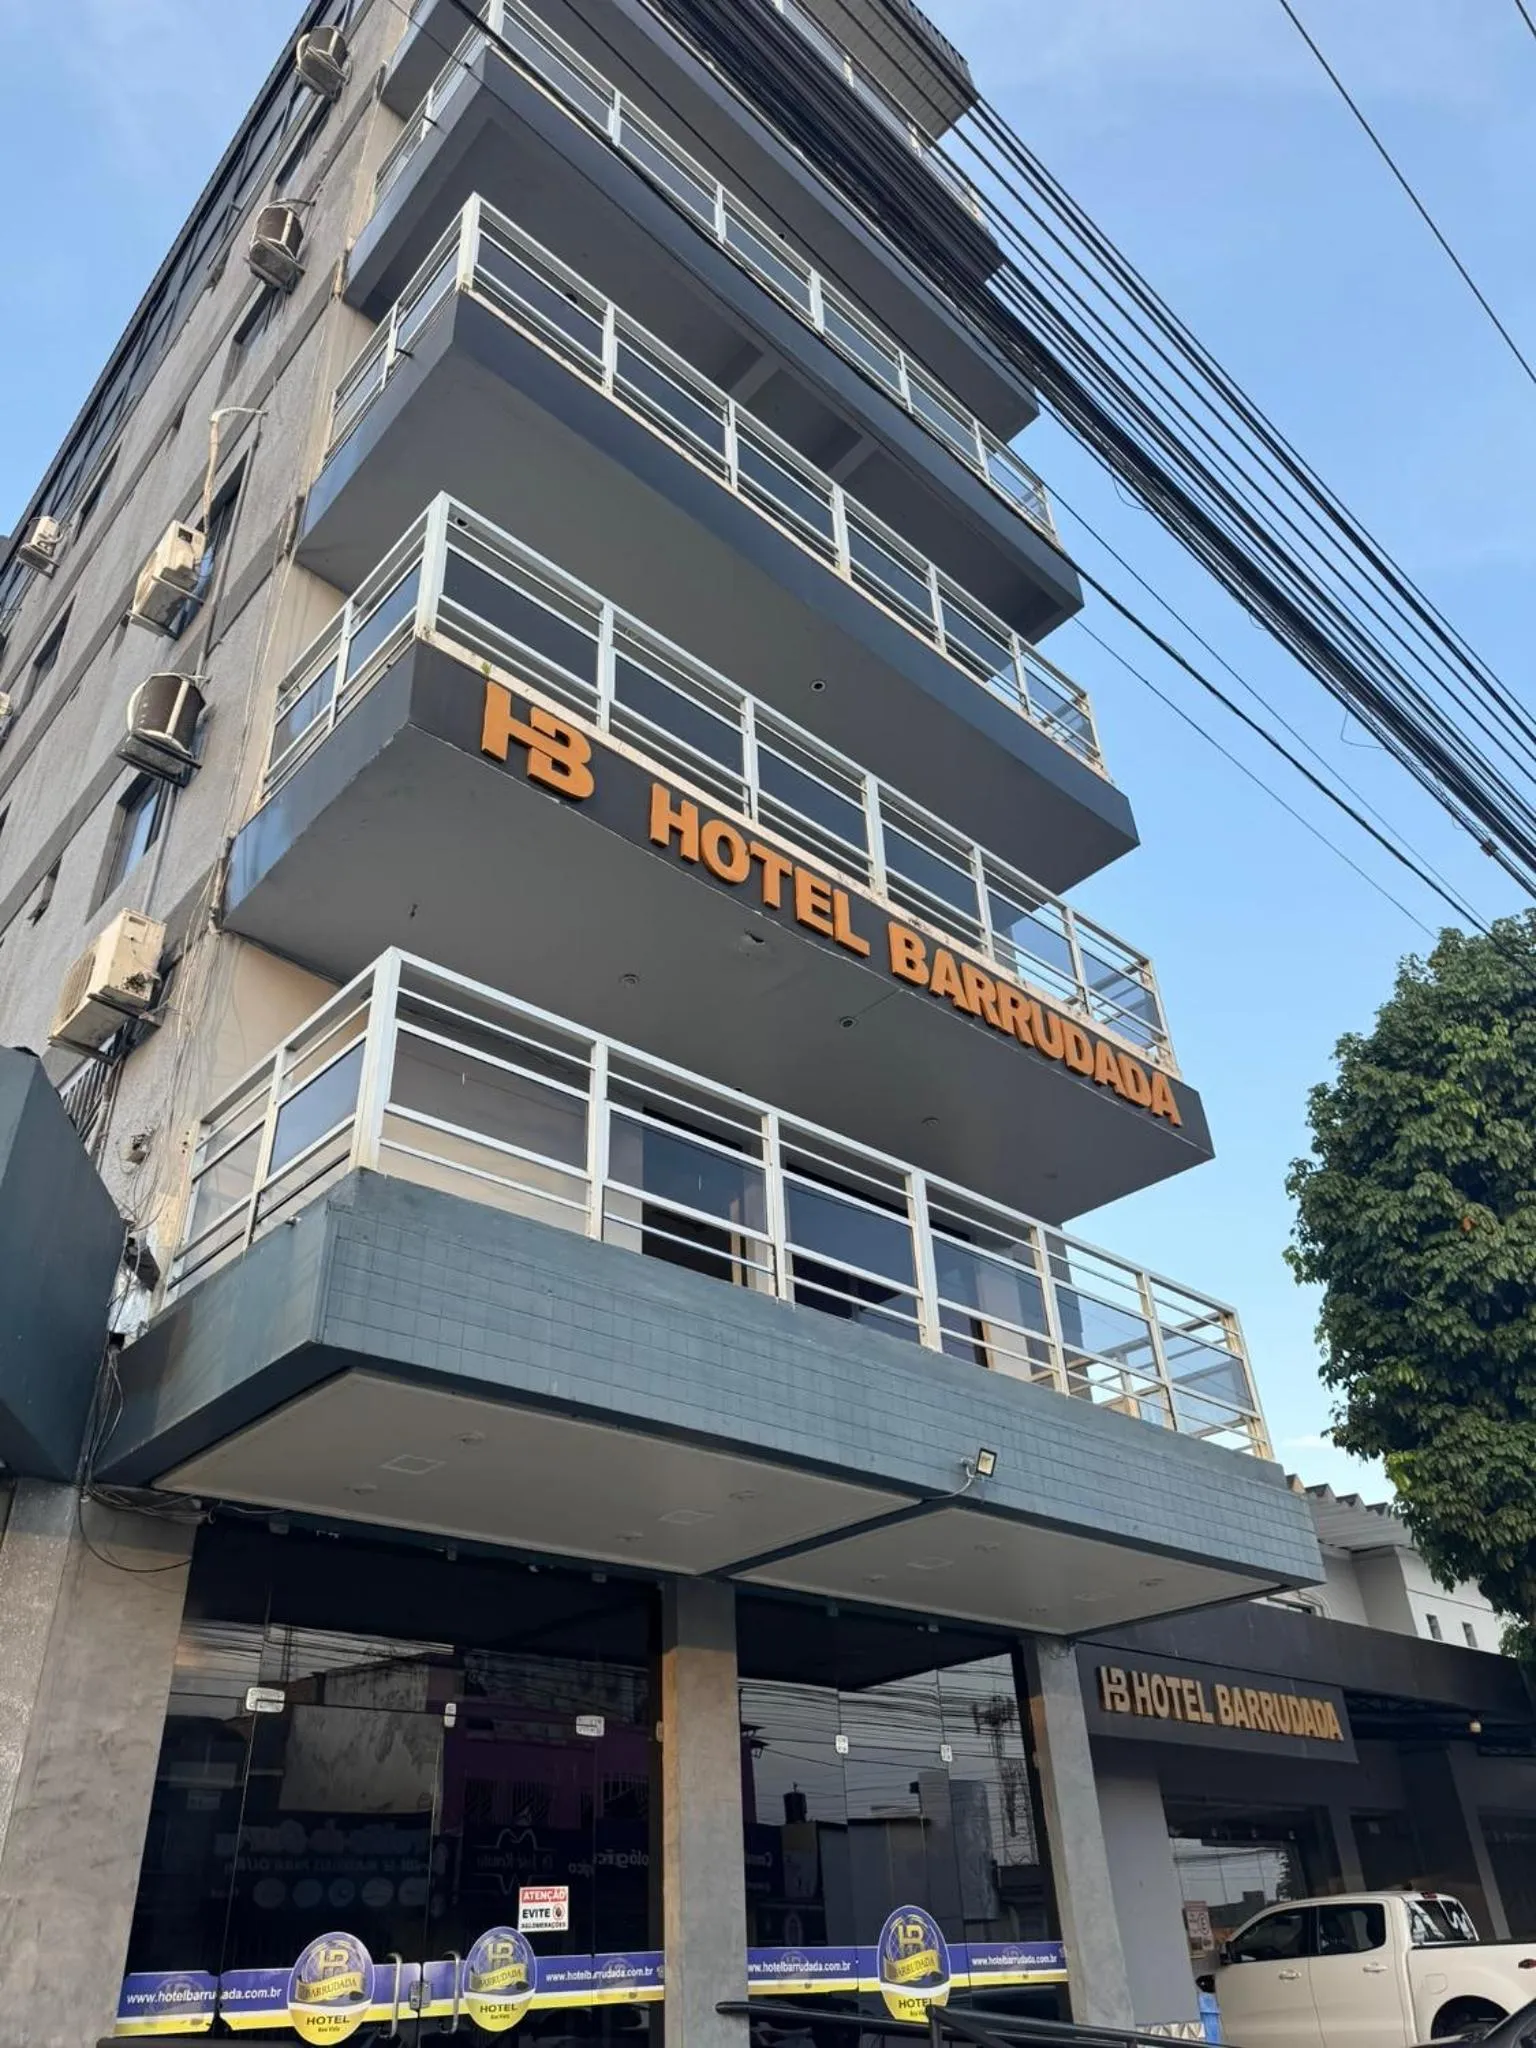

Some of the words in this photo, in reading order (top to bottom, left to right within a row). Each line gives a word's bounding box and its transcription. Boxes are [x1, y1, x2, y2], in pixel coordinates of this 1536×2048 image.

[649, 782, 870, 956] HOTEL
[886, 921, 1183, 1128] BARRUDADA
[1132, 1670, 1214, 1724] HOTEL
[1215, 1684, 1344, 1741] BARRUDADA
[523, 1888, 566, 1902] ATENÇÃO
[522, 1908, 551, 1919] EVITE
[126, 1986, 283, 2004] www.hotelbarruada.com.br
[480, 2003, 518, 2014] HOTEL
[306, 2014, 350, 2026] HOTEL
